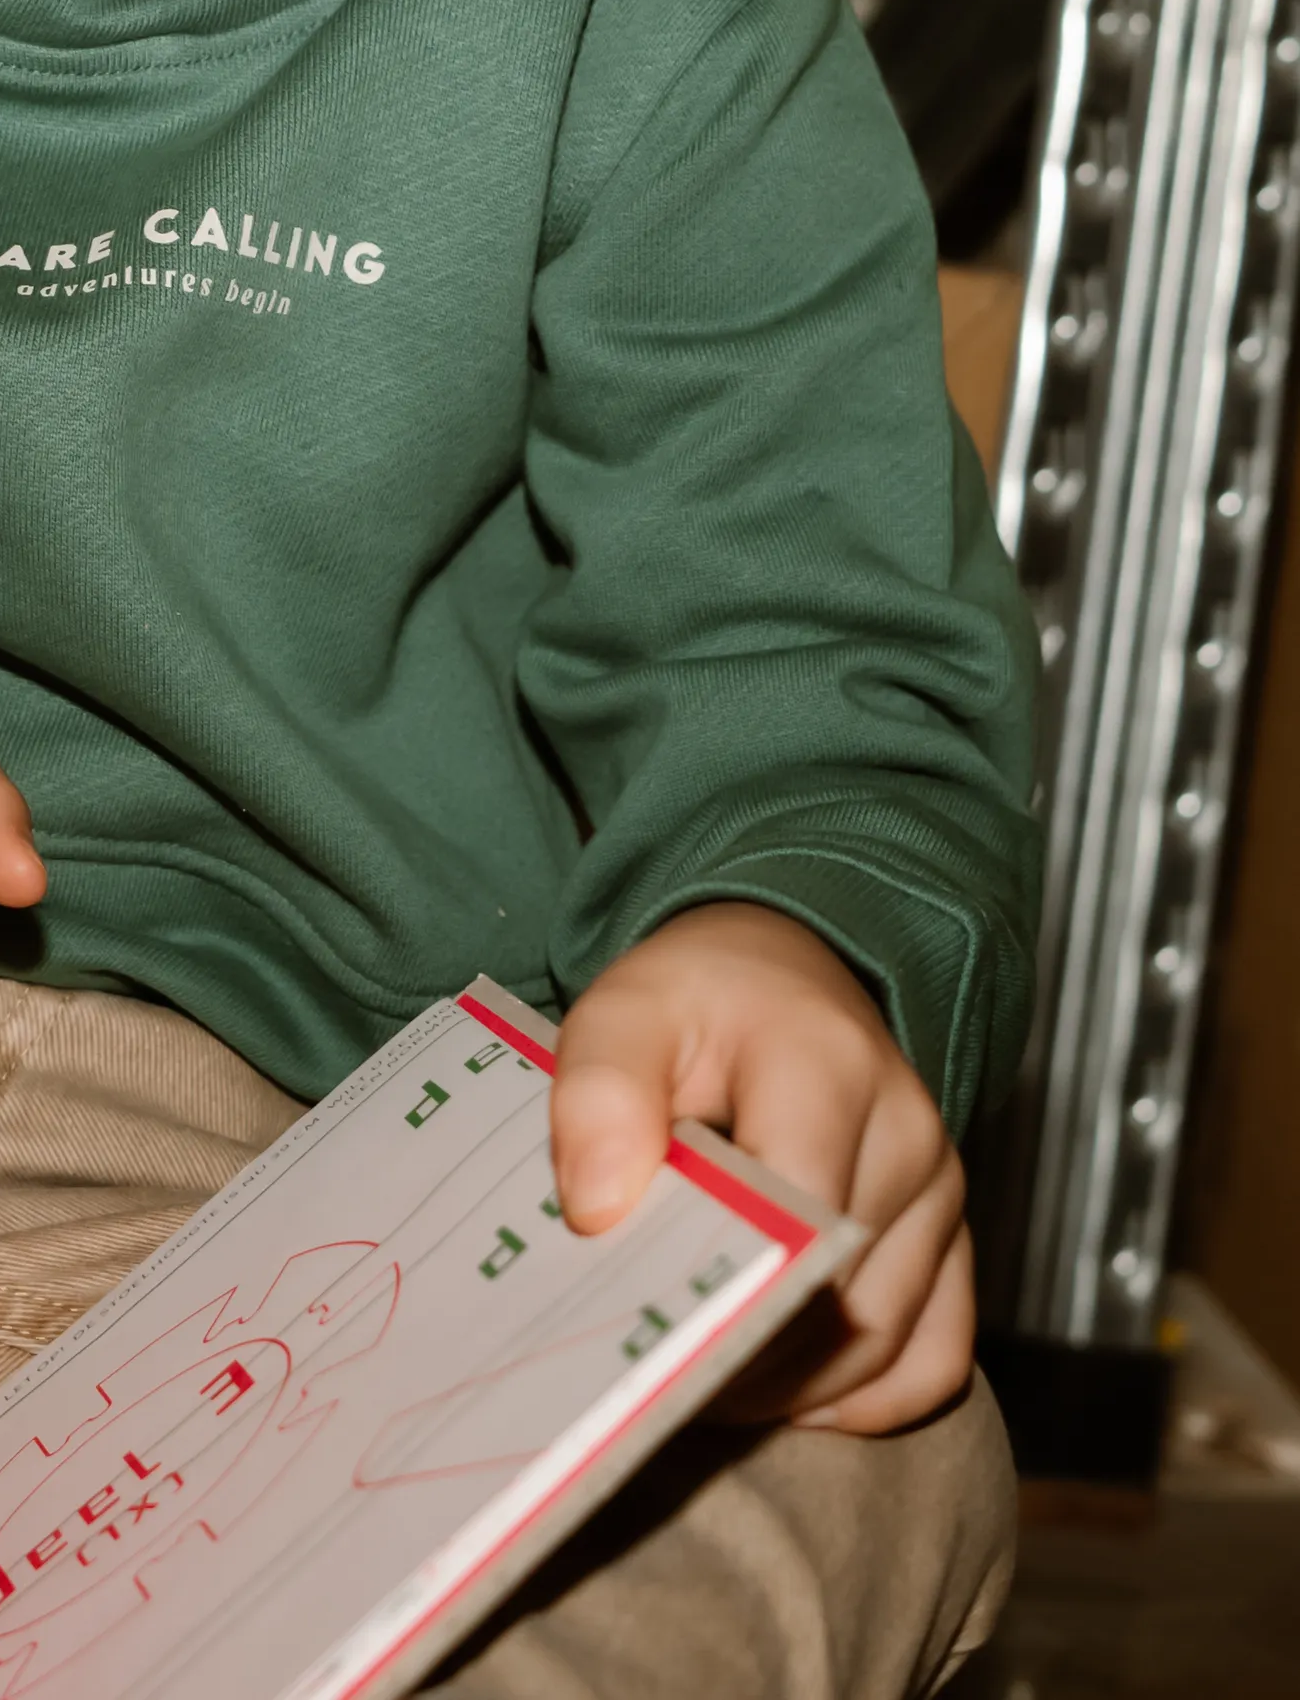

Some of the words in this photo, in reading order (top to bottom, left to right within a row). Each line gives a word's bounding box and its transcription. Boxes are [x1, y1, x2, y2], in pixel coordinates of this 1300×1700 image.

[143, 207, 386, 285] CALLING
[16, 264, 213, 298] adventures
[225, 279, 292, 316] begin
